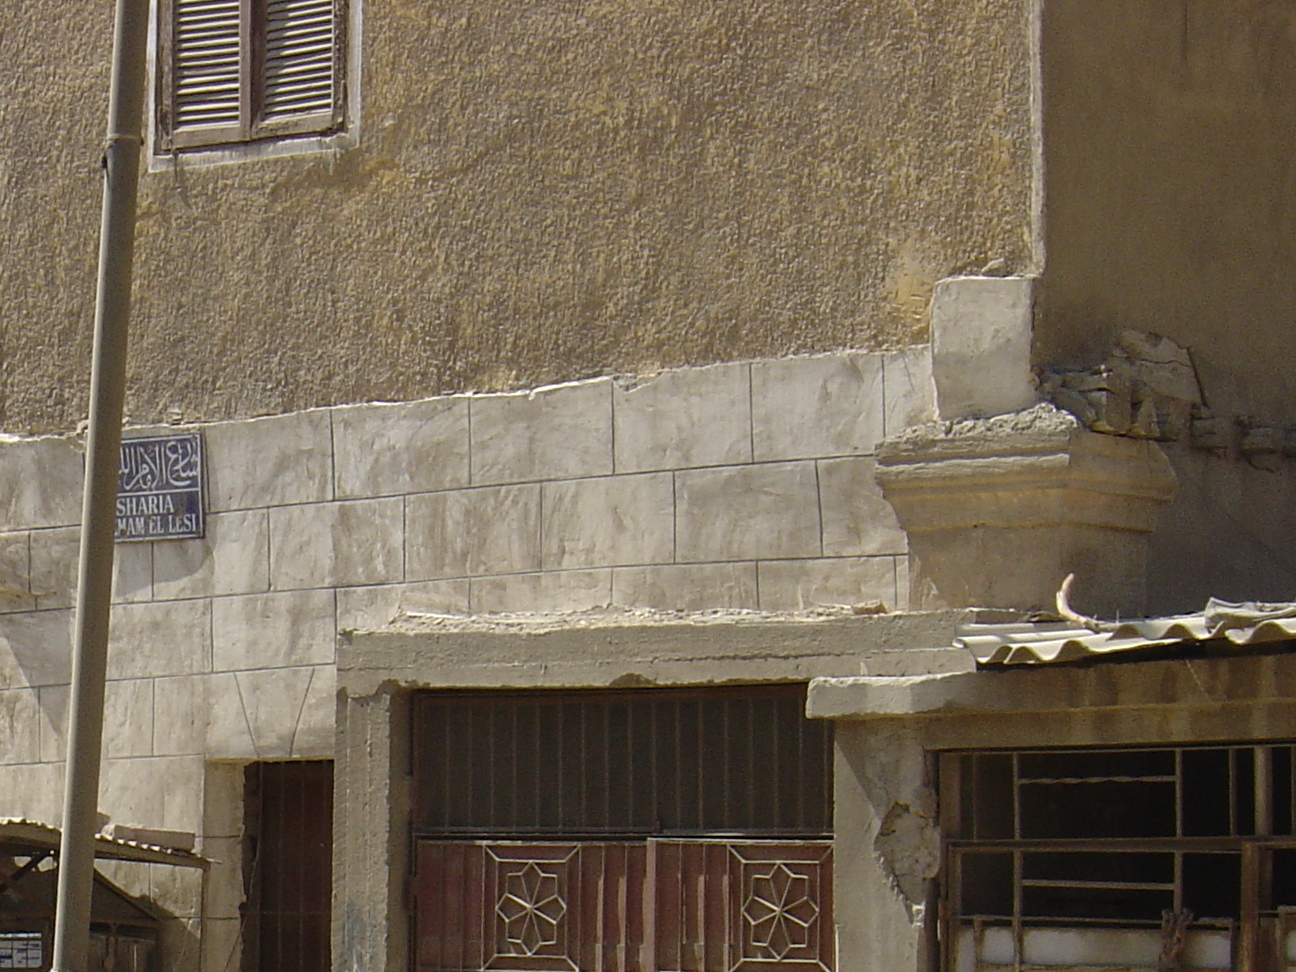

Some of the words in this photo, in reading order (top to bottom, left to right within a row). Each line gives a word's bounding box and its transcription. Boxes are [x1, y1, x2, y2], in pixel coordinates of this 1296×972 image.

[167, 441, 197, 486] شارع
[116, 495, 174, 515] SHARIA
[115, 516, 144, 536] MAM
[149, 515, 164, 534] EL
